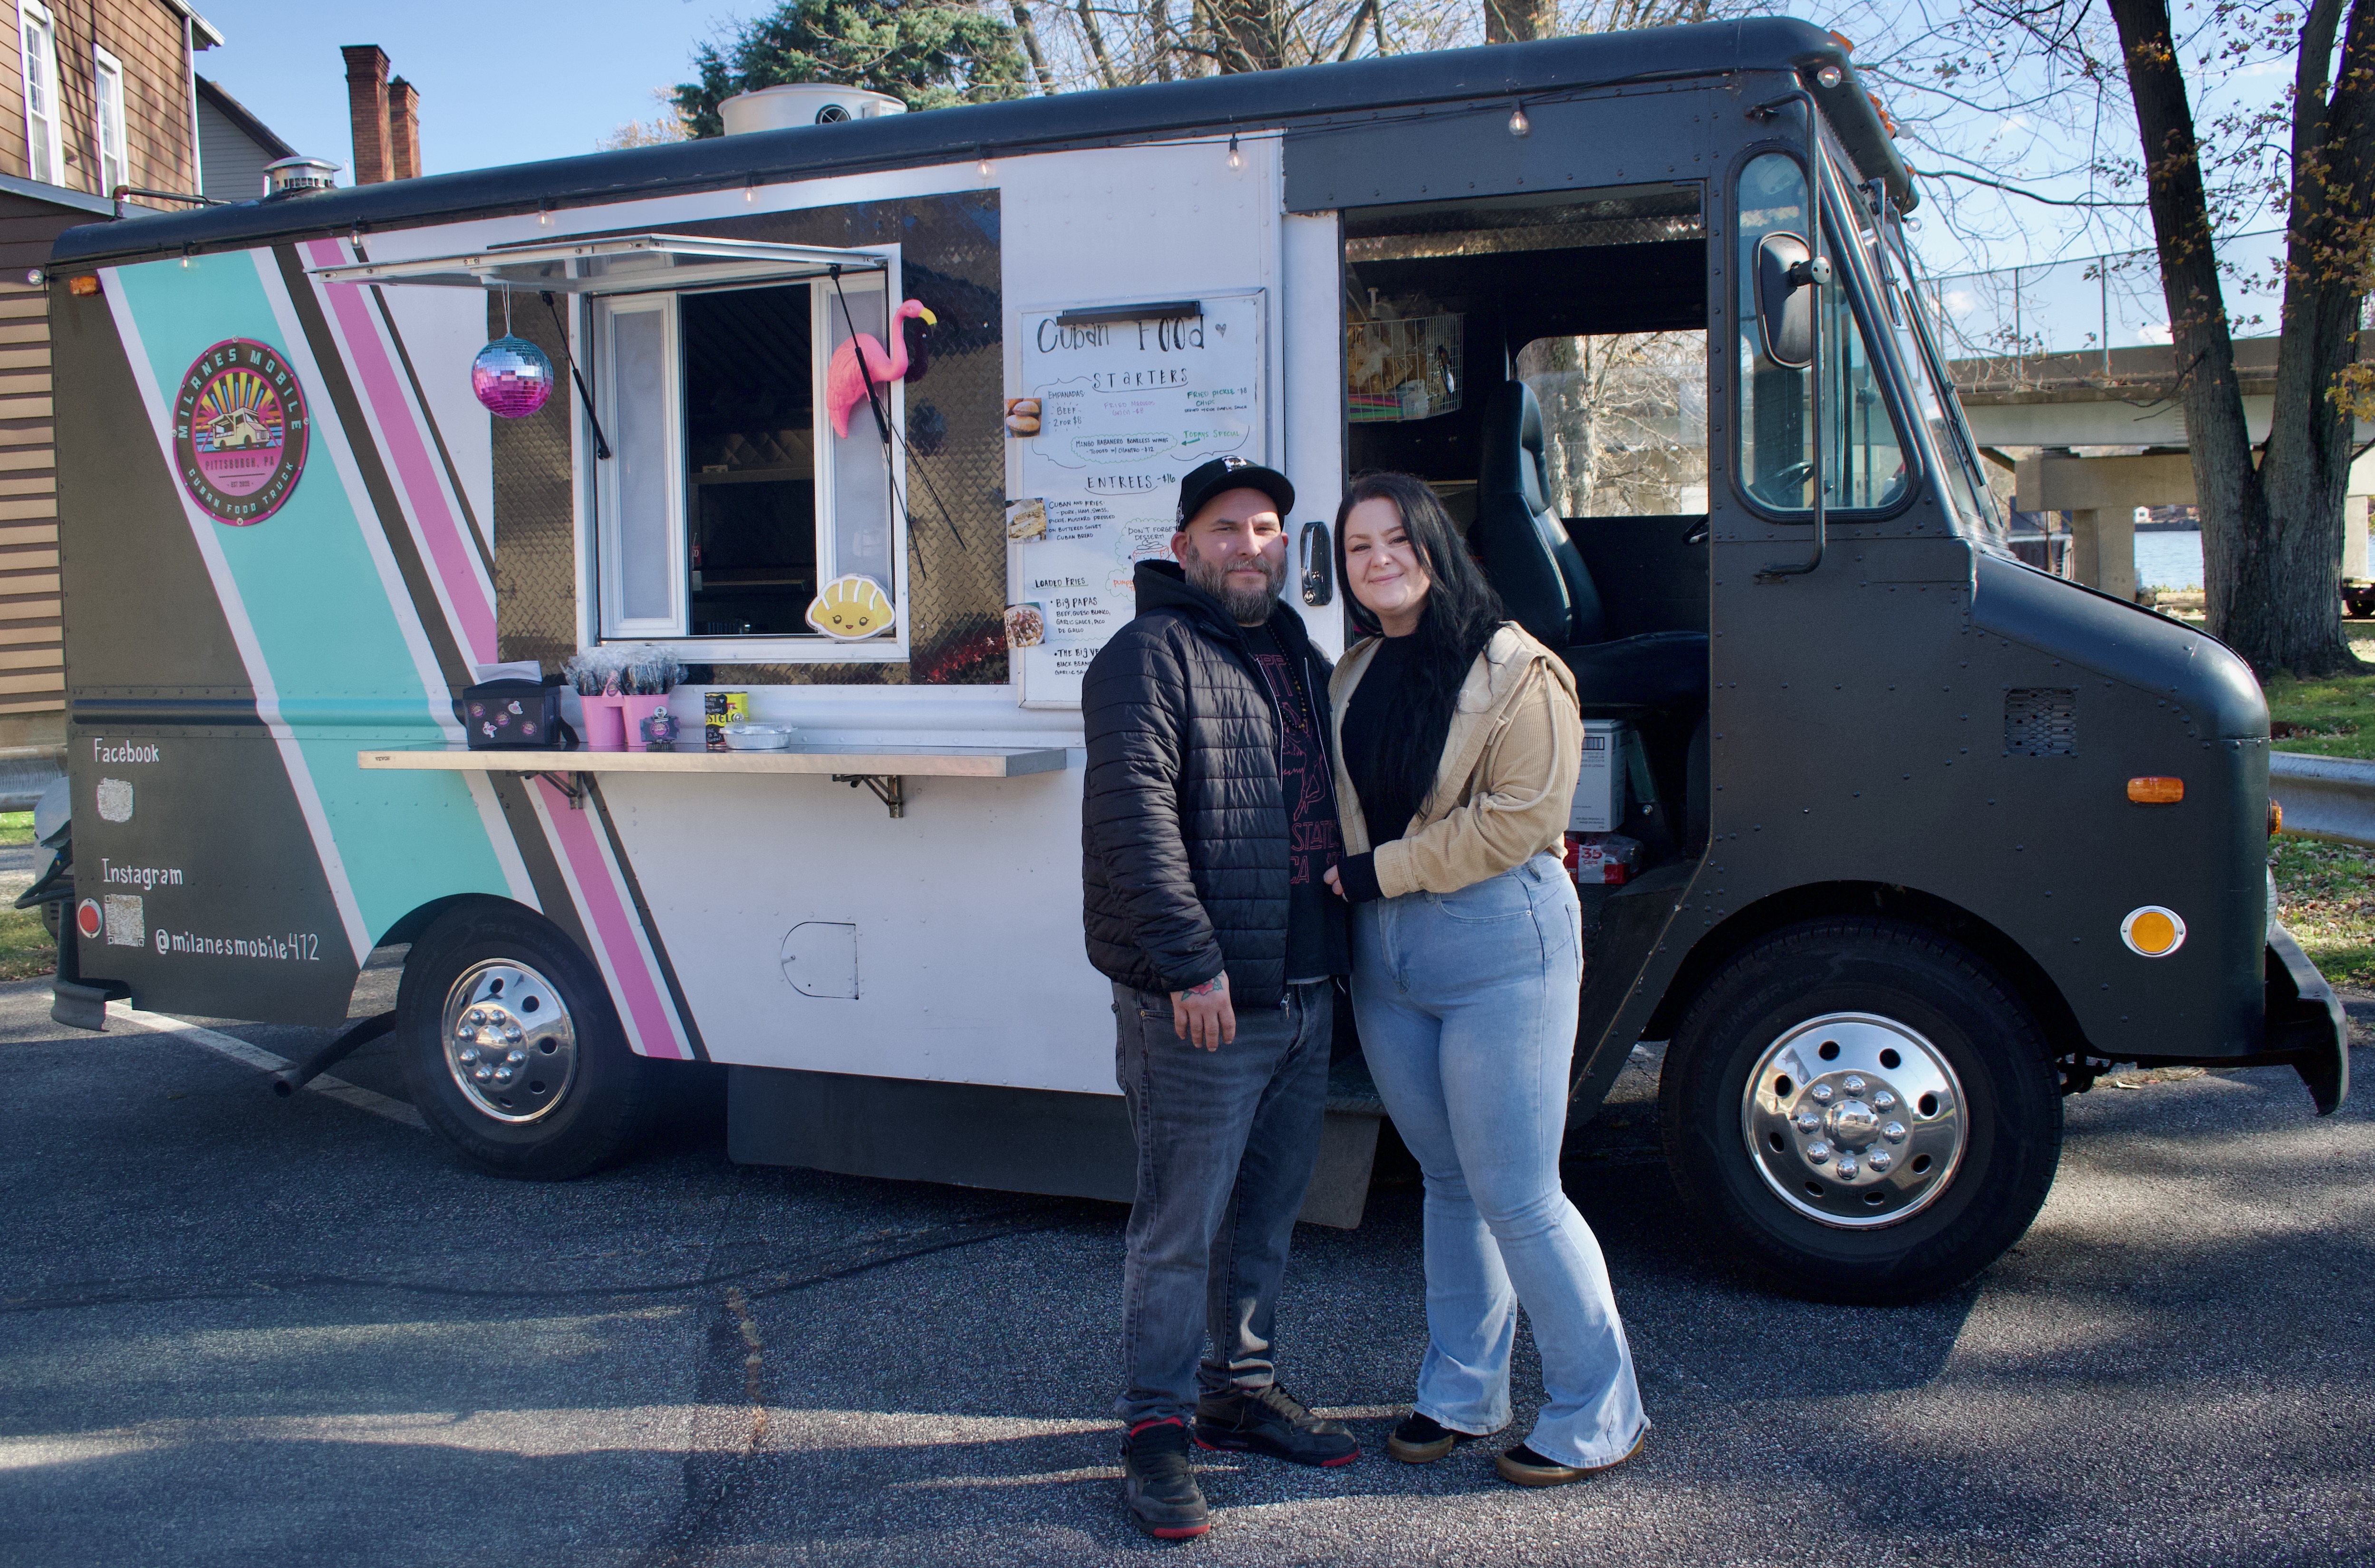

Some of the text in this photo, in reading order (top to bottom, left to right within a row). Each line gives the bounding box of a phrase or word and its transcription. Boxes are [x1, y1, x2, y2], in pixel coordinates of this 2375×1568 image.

[178, 348, 302, 439] MILANES MOBILE
[1187, 391, 1209, 399] FRIED
[1212, 388, 1235, 398] PICKLE
[1056, 406, 1076, 415] BEEF
[1053, 418, 1059, 427] 2
[1183, 429, 1240, 440] TODAYS SPECIAL
[264, 456, 275, 466] PA
[1087, 475, 1153, 489] ENTREES
[189, 462, 294, 515] CUBAN FOOD TRUCK
[1049, 501, 1071, 509] CUBAN
[1153, 525, 1177, 533] FORGET
[1035, 577, 1086, 588] LOADED FRIES
[1113, 579, 1134, 588] PUMPK
[1072, 596, 1098, 608] PAPAS
[1057, 649, 1073, 657] THE
[94, 738, 160, 763] Facebook
[101, 858, 184, 891] Instagram
[154, 928, 320, 961] @milanesmobile412
